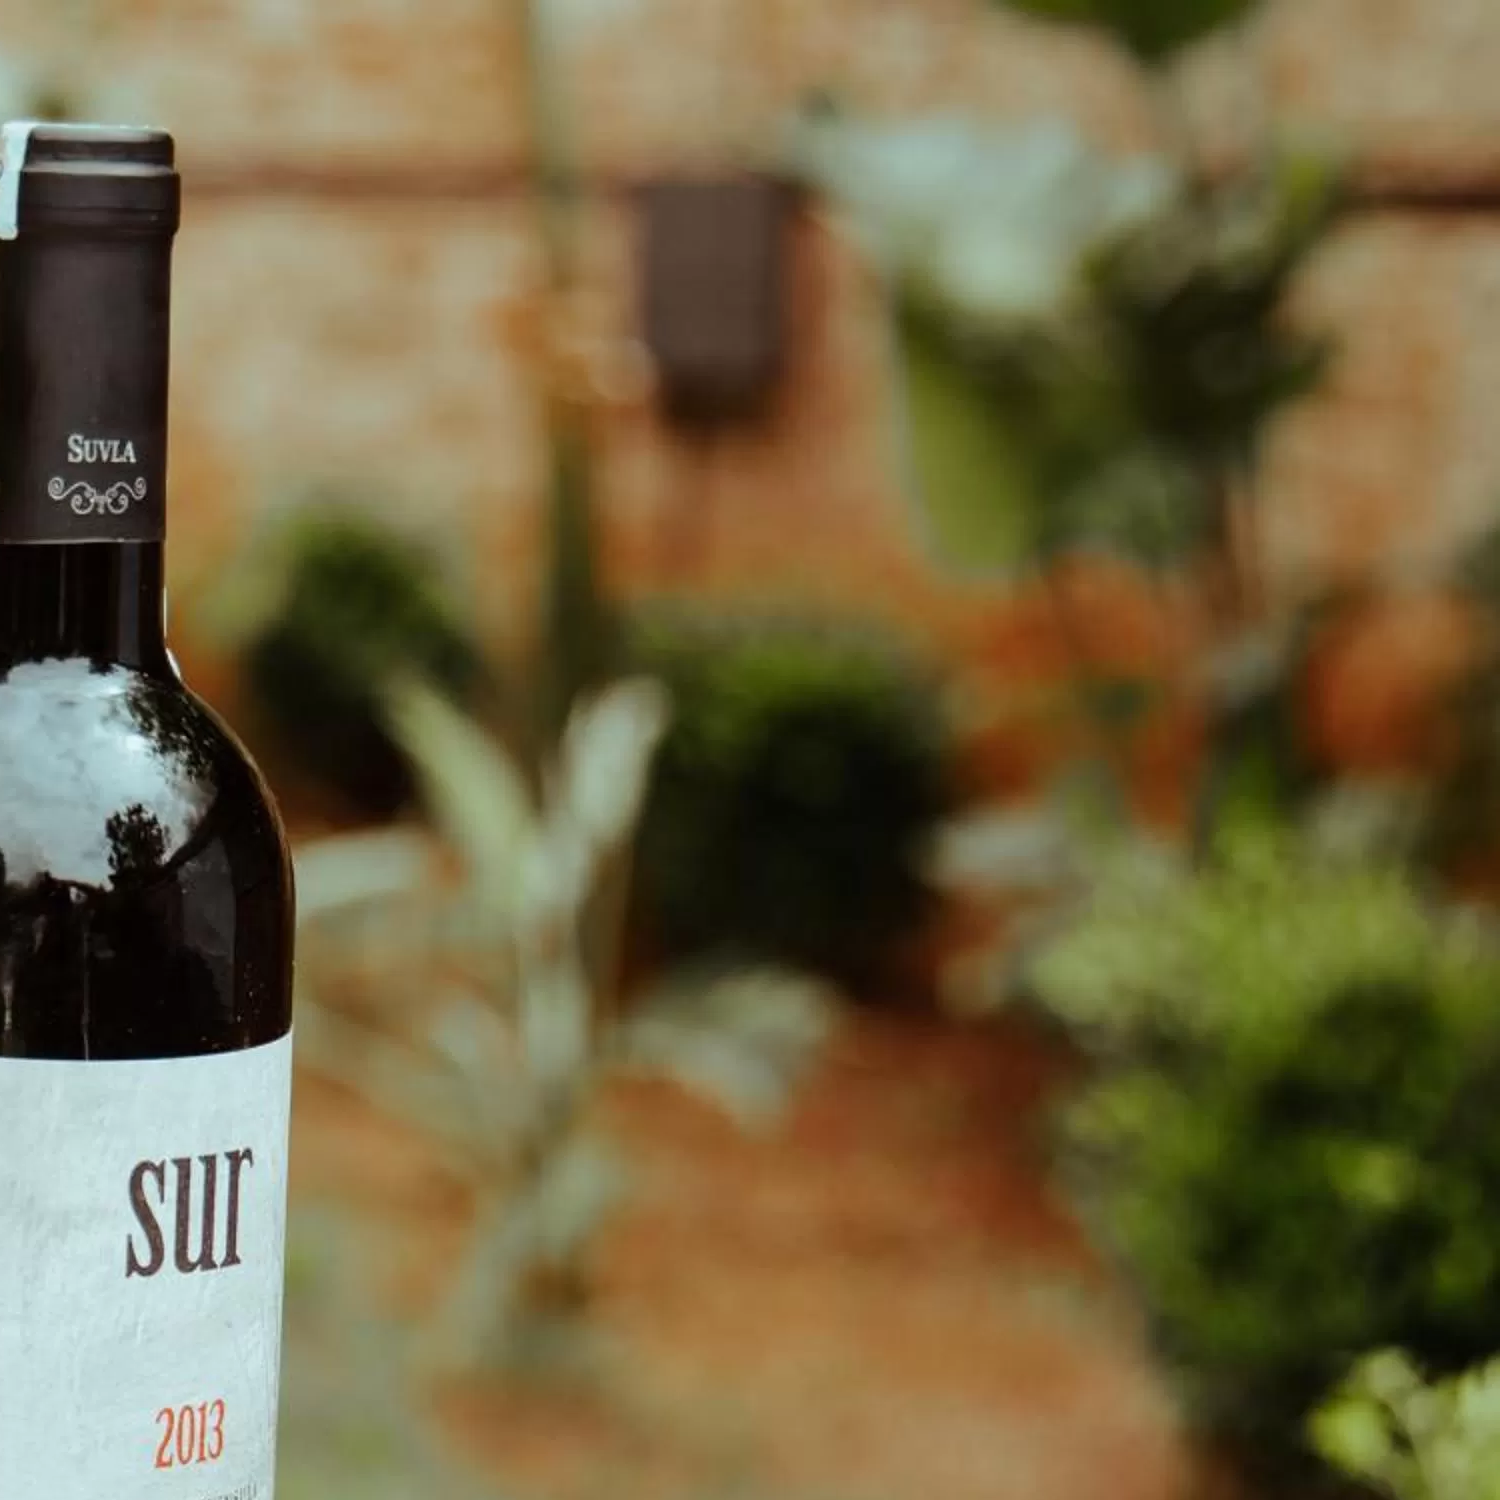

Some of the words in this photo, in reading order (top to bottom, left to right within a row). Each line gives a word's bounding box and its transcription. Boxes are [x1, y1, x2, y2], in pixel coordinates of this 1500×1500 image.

[67, 433, 137, 465] SUVLA
[124, 1146, 254, 1279] sur
[155, 1398, 226, 1469] 2013
